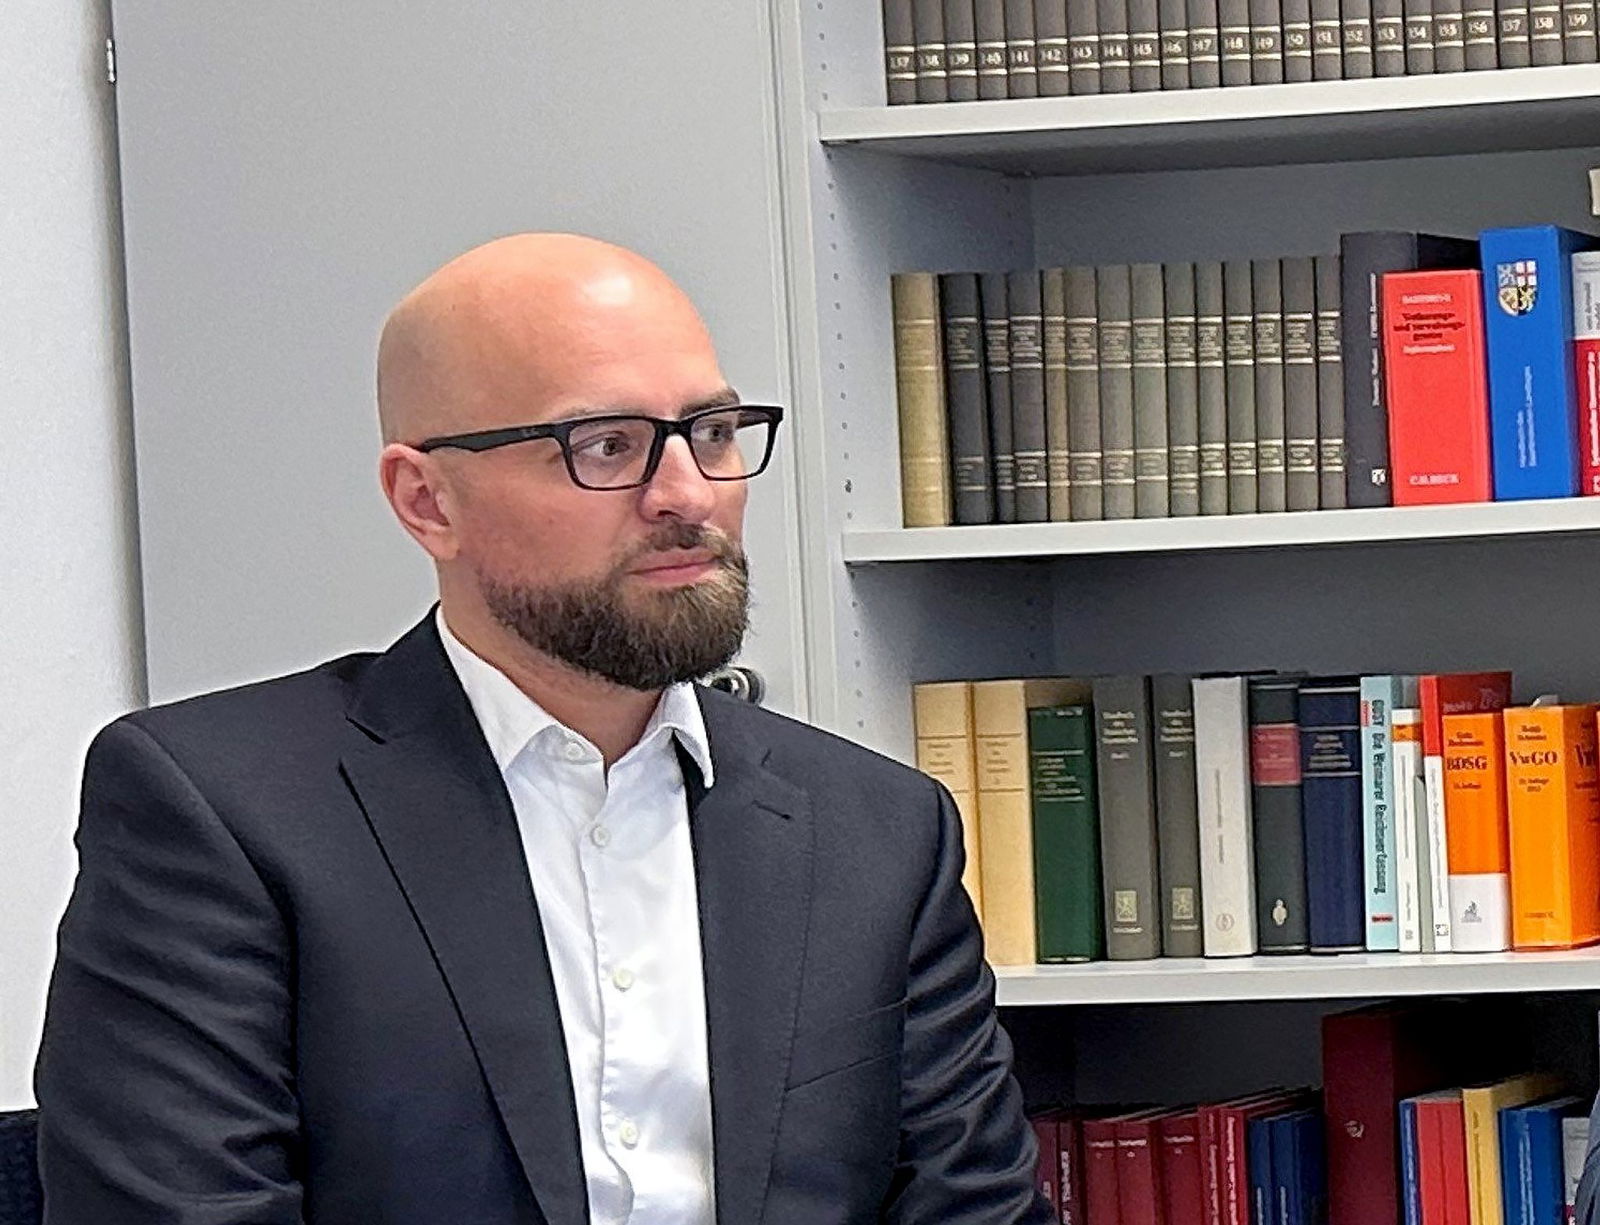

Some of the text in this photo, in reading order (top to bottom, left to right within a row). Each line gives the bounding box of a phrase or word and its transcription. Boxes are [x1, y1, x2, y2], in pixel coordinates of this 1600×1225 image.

[1468, 20, 1488, 34] 156
[1502, 19, 1521, 32] 157
[1534, 16, 1554, 30] 158
[1567, 13, 1588, 27] 159
[1408, 26, 1426, 39] 154
[1193, 38, 1212, 52] 147
[1254, 36, 1274, 50] 149
[1372, 733, 1386, 751] Die
[1446, 755, 1488, 771] BDSG
[1509, 751, 1558, 766] VwGO
[1374, 753, 1386, 800] Weimarer
[1374, 804, 1388, 895] Reichsverfassung
